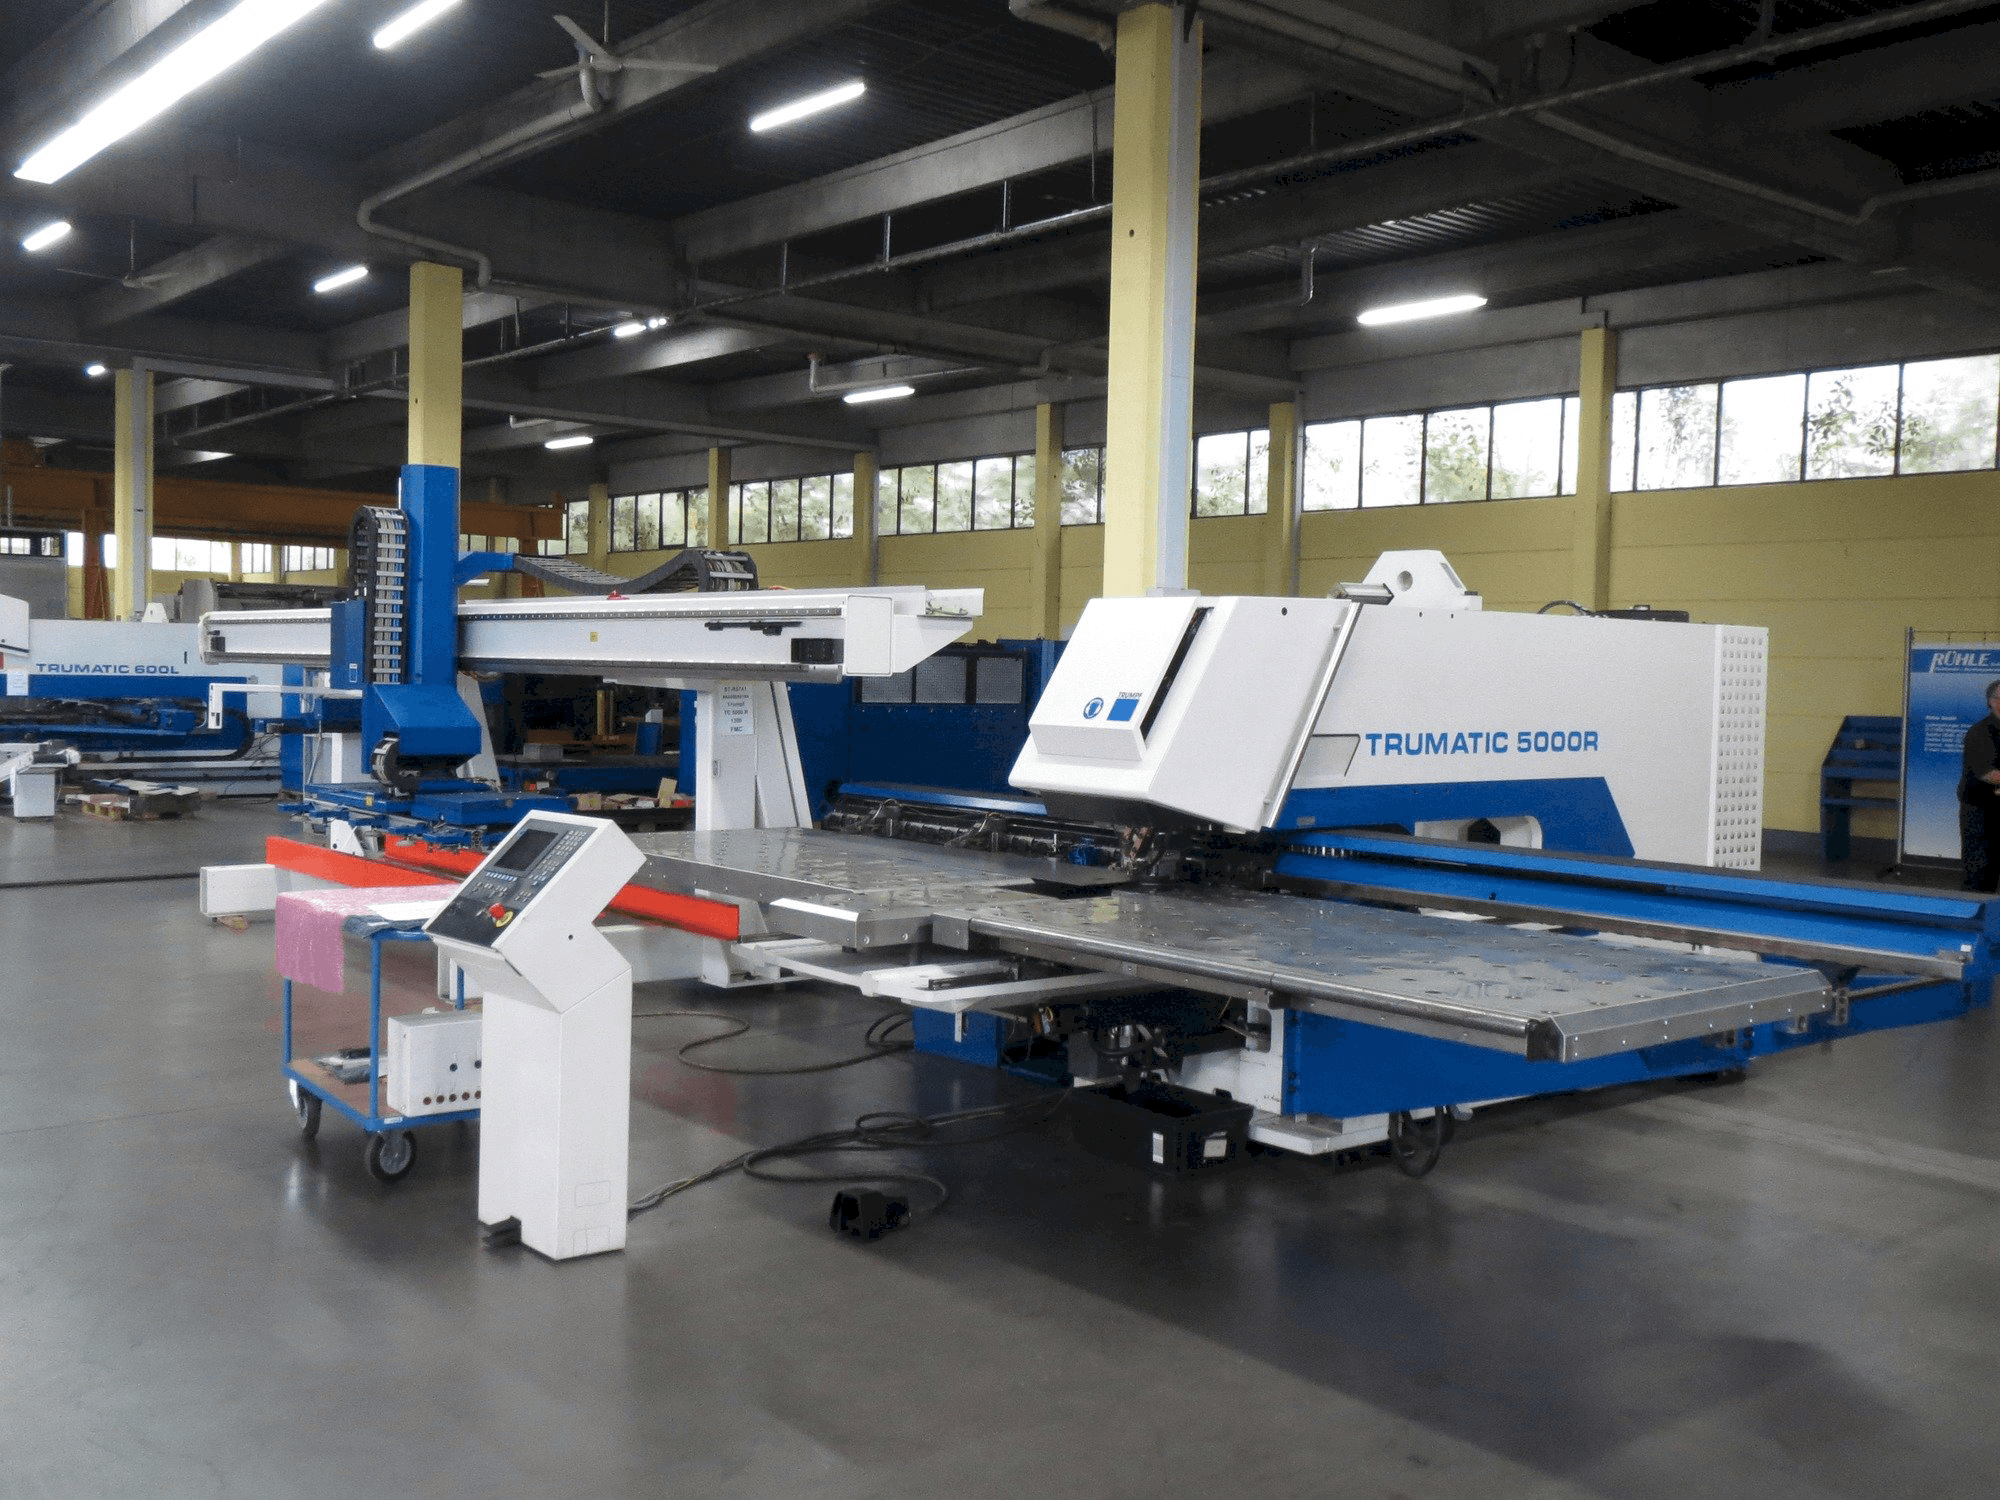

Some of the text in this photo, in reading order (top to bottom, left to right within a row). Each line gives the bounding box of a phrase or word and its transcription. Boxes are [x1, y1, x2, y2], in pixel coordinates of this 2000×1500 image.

[36, 663, 180, 675] TRUMATIC 600L
[1929, 650, 1991, 673] RÜHLE
[1364, 731, 1599, 756] TRUMATIC 5000R
